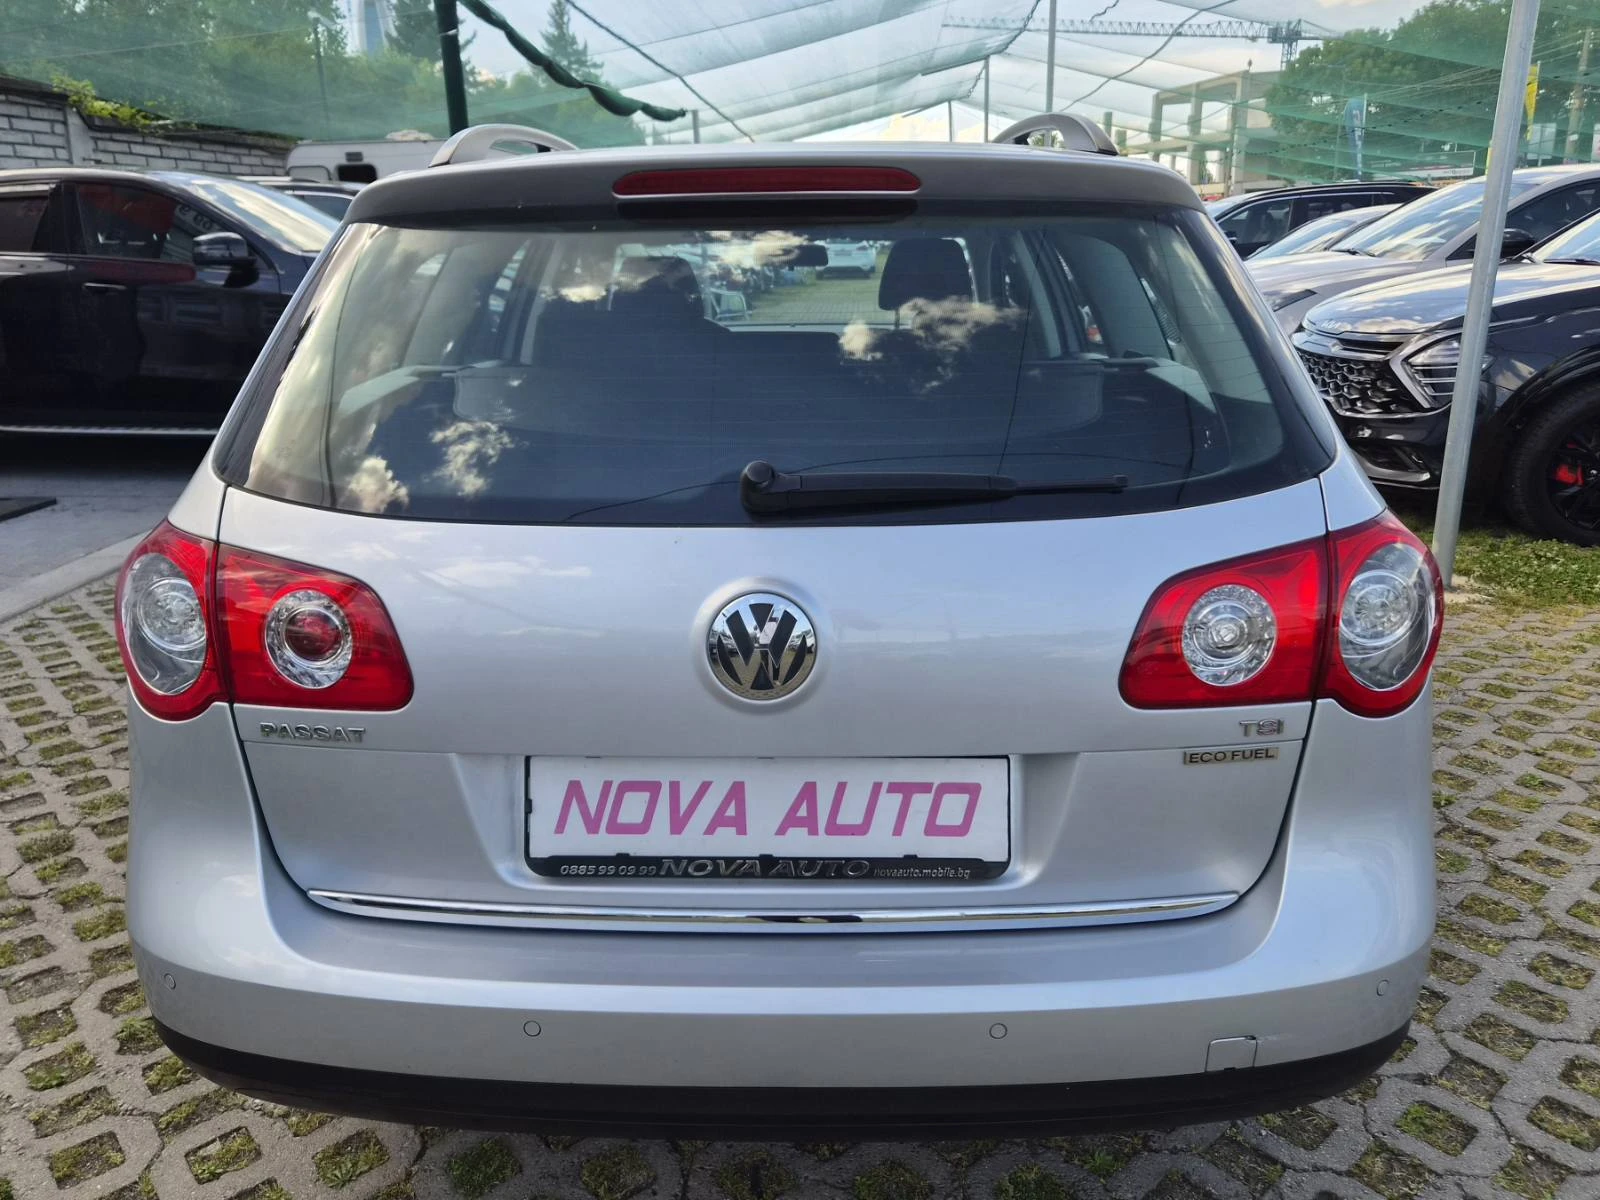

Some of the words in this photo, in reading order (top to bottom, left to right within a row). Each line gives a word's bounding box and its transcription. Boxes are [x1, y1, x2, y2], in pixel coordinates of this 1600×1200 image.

[259, 721, 366, 742] PASSAT
[1239, 719, 1284, 737] TSI
[553, 779, 748, 836] NOVA
[774, 781, 982, 838] AUTO
[560, 864, 596, 876] 0885
[598, 864, 616, 876] 99
[617, 864, 636, 876] 09
[658, 858, 761, 877] NOVA
[768, 859, 870, 877] AUTO
[873, 866, 972, 880] novaauto.mobile.bg
